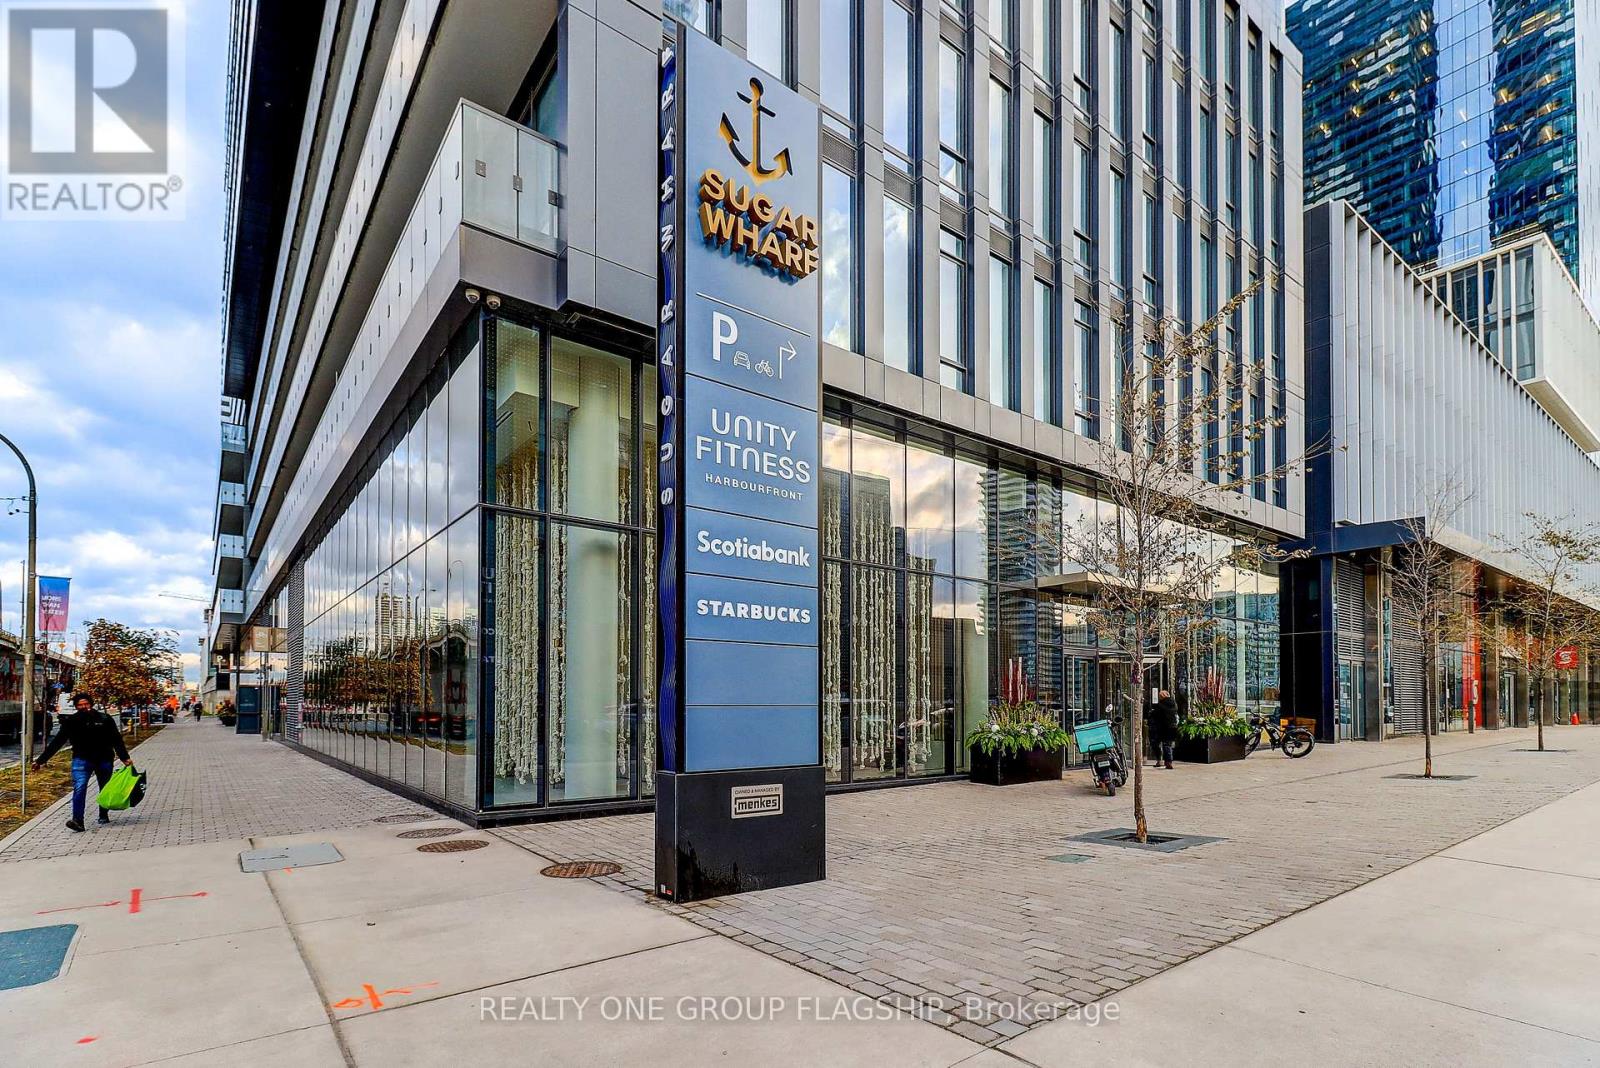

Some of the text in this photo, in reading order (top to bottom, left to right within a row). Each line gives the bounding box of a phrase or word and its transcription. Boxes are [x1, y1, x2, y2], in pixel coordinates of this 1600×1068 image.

[700, 168, 819, 247] SUGAR
[700, 201, 820, 278] WHARF
[711, 310, 738, 362] P
[711, 407, 797, 451] UNITY
[695, 434, 812, 484] FITNESS
[705, 472, 804, 502] HARBOURFRONT
[696, 529, 811, 568] Scotiabank
[696, 598, 812, 624] STARBUCKS
[738, 799, 777, 810] menkes
